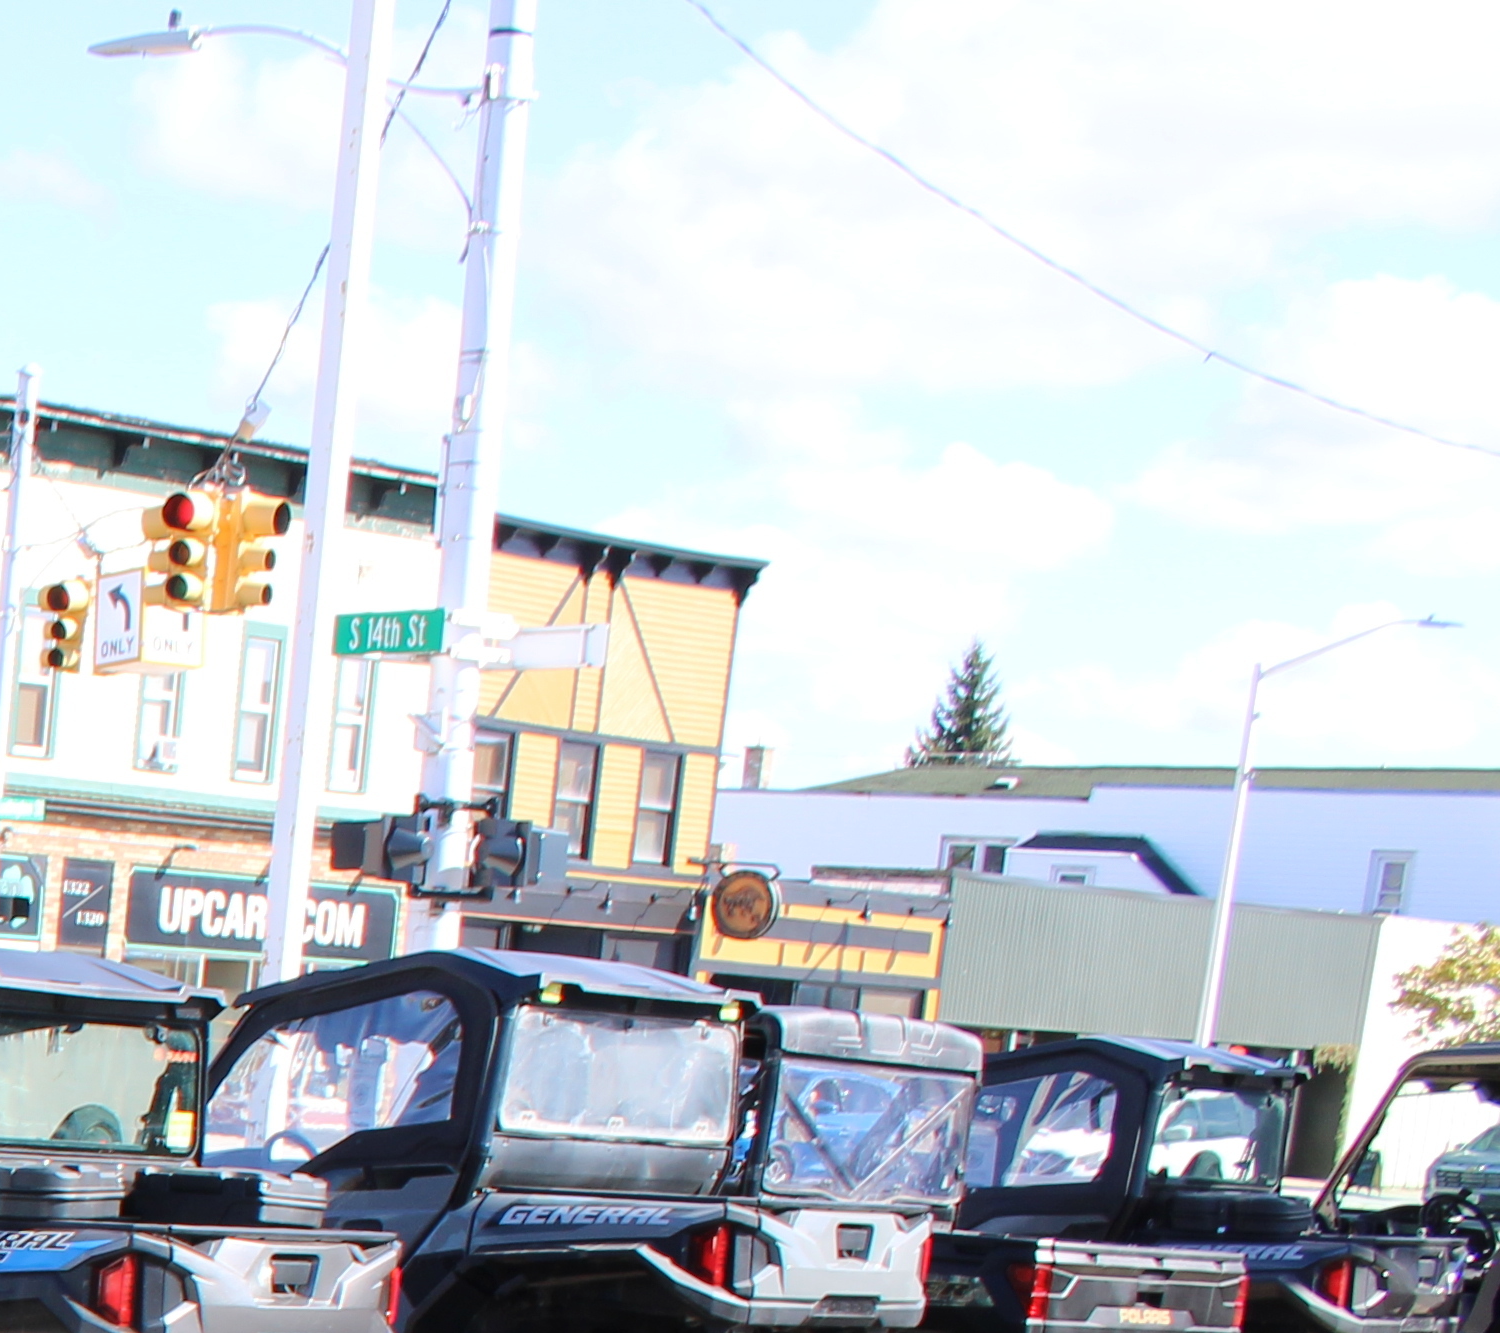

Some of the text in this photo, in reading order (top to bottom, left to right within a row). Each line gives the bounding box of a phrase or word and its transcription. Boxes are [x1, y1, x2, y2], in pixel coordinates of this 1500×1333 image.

[349, 614, 428, 650] S 14th St
[101, 636, 135, 658] ONLY
[63, 879, 92, 896] 1322
[498, 1205, 673, 1225] GENERAL
[1119, 1308, 1173, 1325] POLARIS
